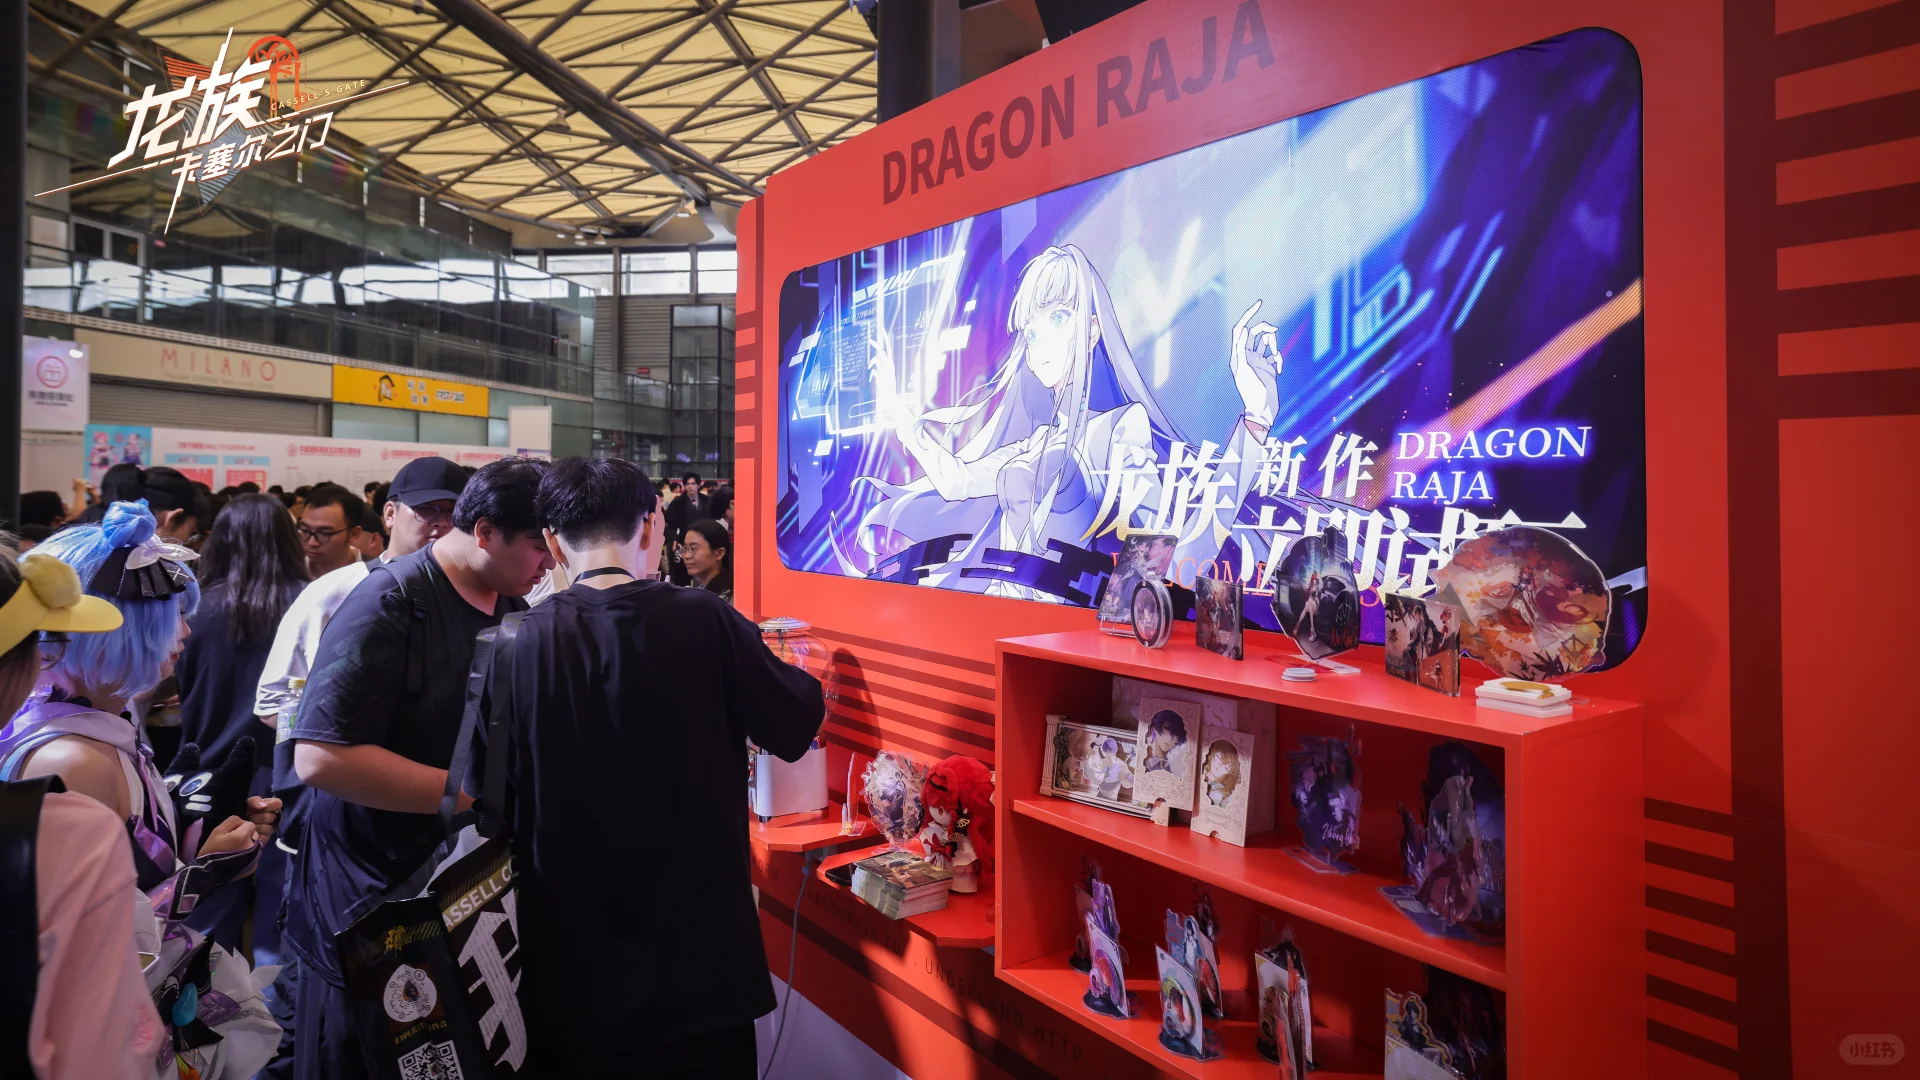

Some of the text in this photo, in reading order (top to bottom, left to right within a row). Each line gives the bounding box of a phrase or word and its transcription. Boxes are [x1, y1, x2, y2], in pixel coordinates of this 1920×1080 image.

[882, 0, 1276, 206] DRAGON RAJA
[160, 347, 277, 382] MILANO
[1395, 426, 1593, 460] DRAGON
[1390, 470, 1494, 505] RAJA
[925, 957, 1083, 1064] UNDERLAND HTTP
